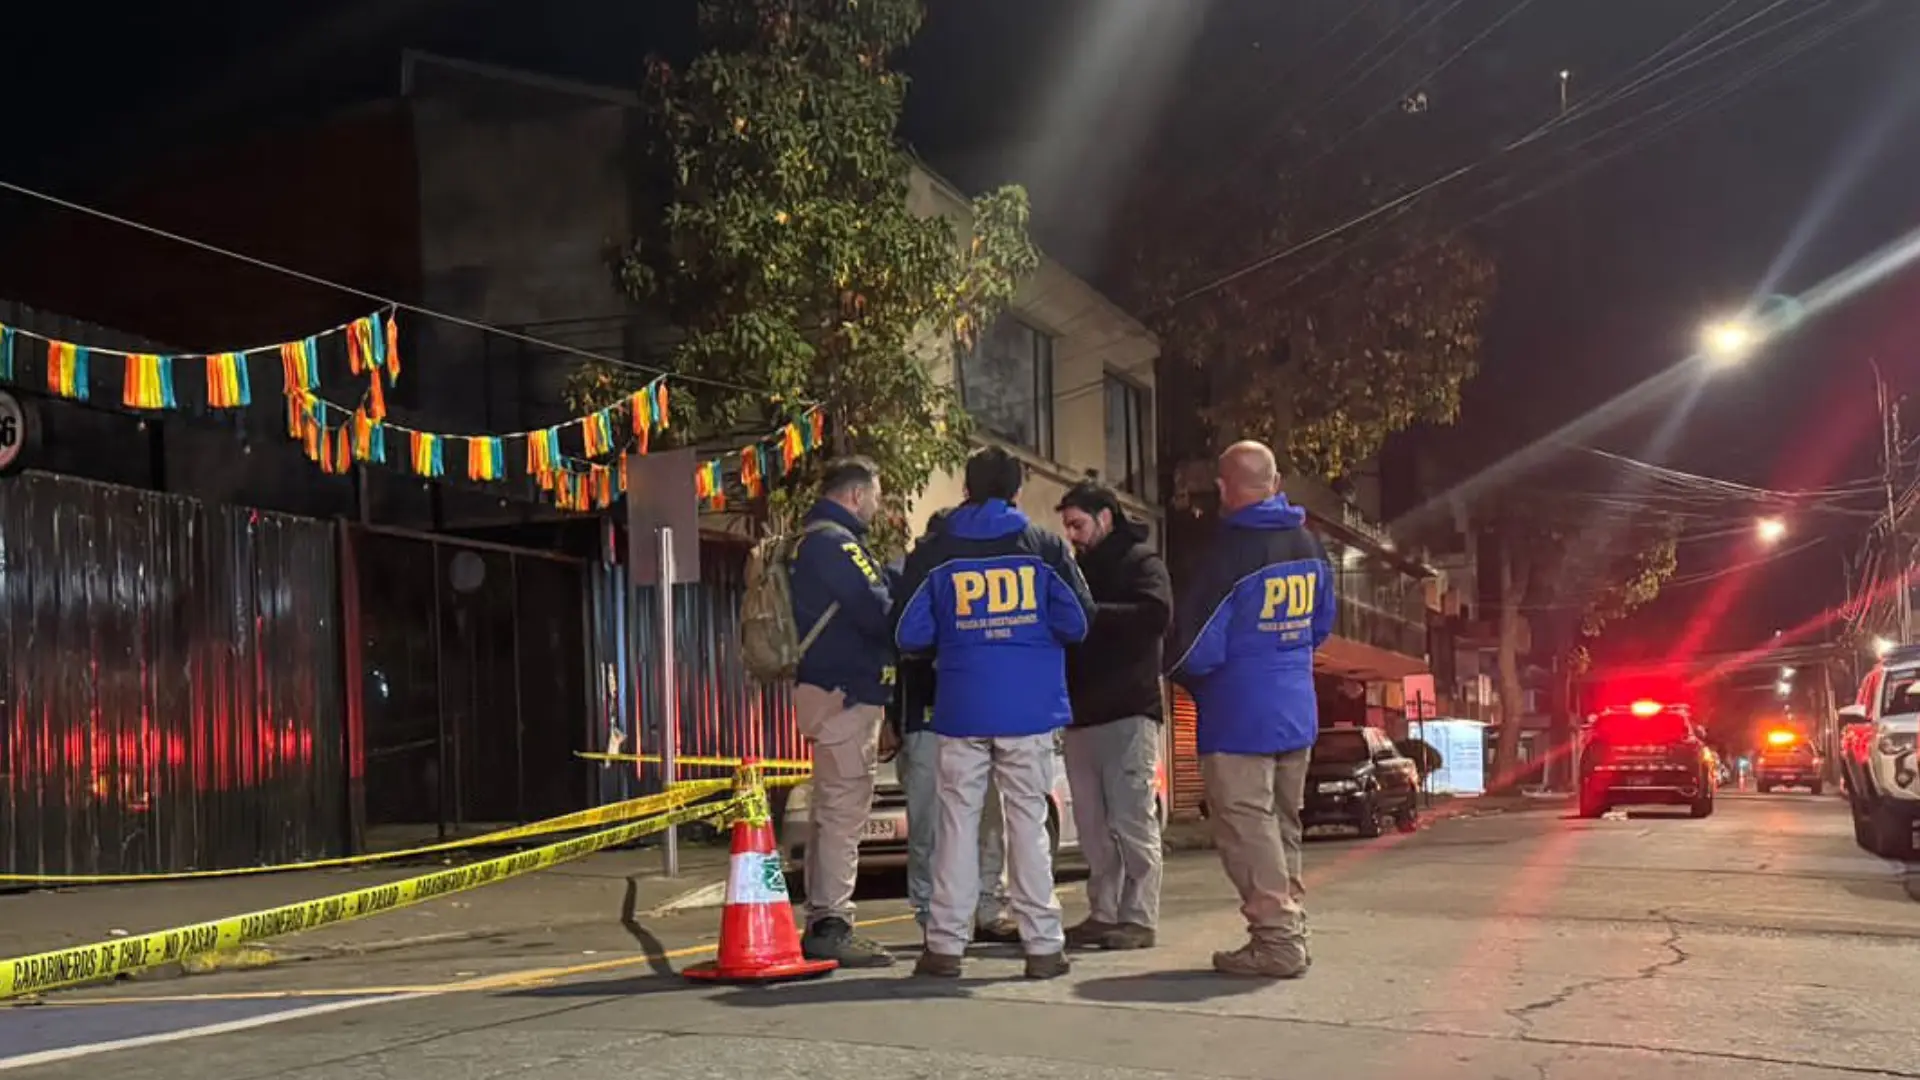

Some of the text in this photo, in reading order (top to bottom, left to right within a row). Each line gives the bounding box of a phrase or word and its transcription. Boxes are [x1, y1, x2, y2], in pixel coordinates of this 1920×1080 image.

[951, 566, 1037, 616] PDI
[1259, 572, 1316, 619] PDI
[239, 906, 305, 943] CARABINEROS
[306, 902, 322, 928] DE
[12, 948, 98, 992] CARABINEROS
[100, 944, 116, 973] DE
[118, 938, 151, 969] CHILE
[161, 931, 180, 961] NO
[179, 924, 219, 961] PASAR
